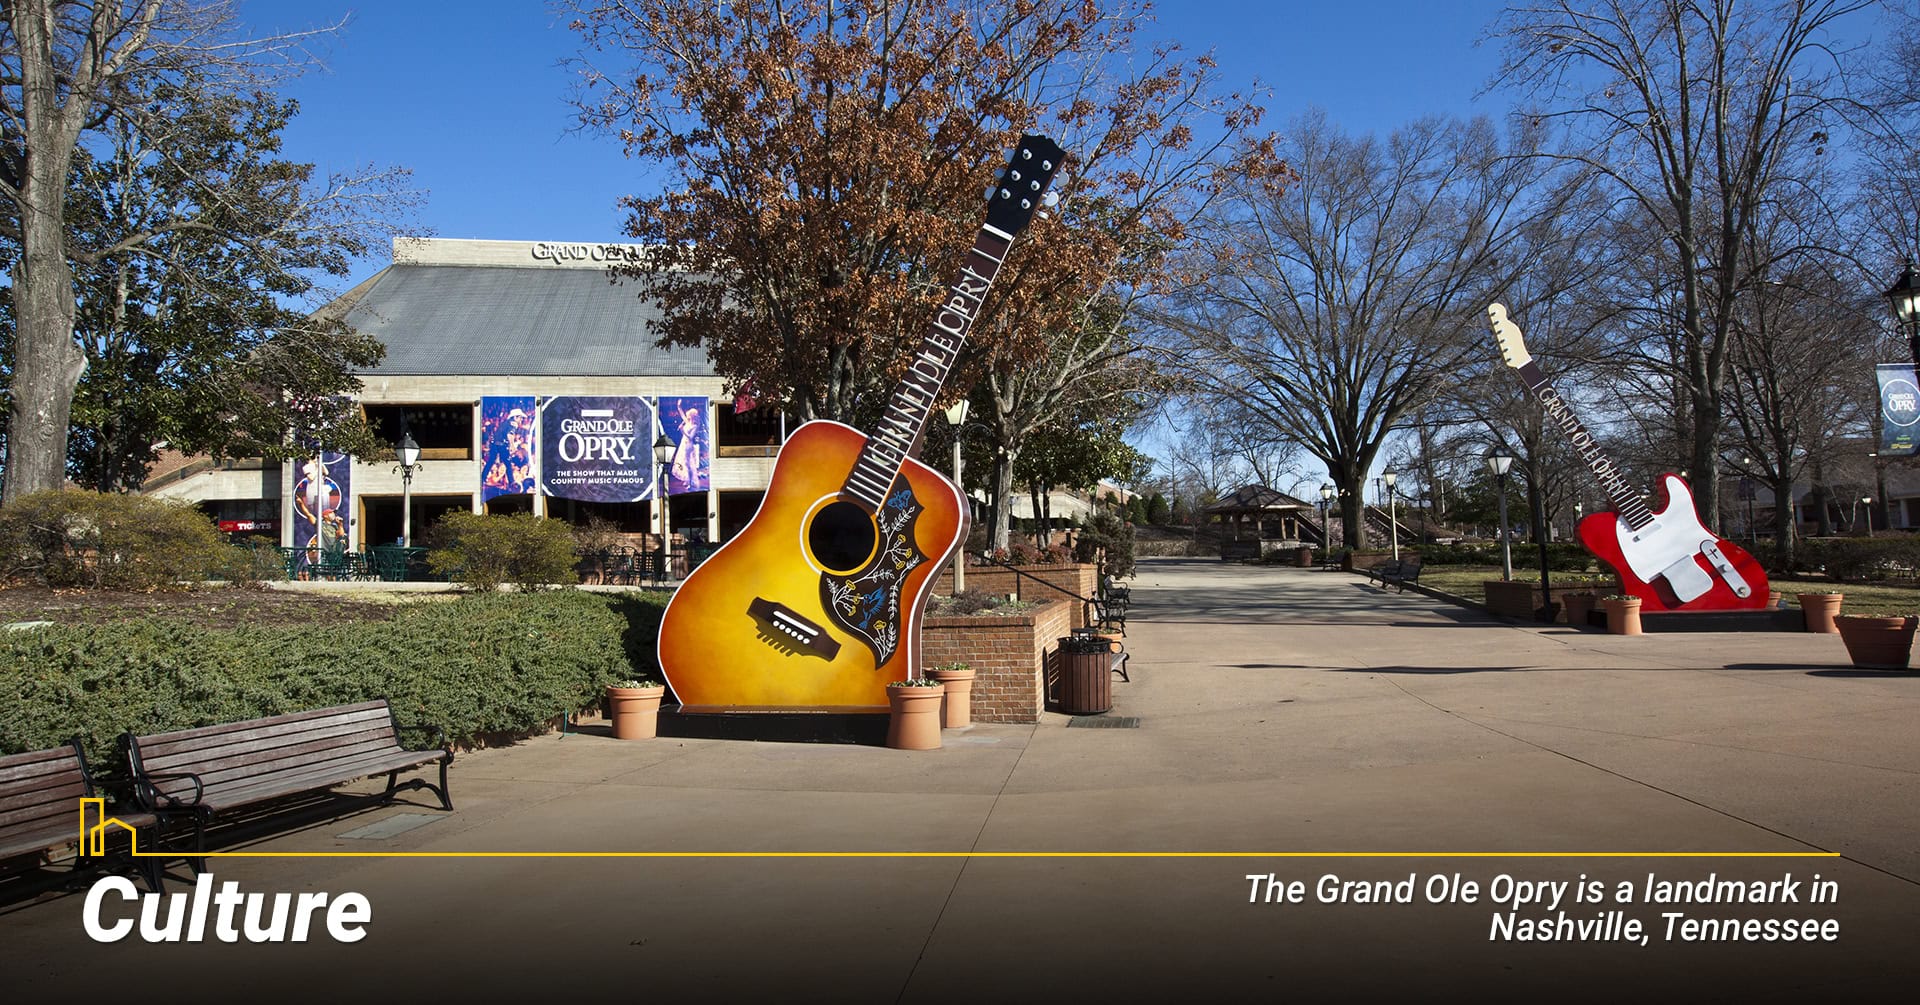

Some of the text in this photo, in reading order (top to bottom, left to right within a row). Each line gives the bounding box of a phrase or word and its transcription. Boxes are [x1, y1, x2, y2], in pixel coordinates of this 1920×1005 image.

[531, 243, 588, 264] GRAND
[871, 384, 926, 466] GRAND
[938, 265, 987, 335] OPRY
[561, 418, 634, 434] GRAND OLE
[1539, 387, 1577, 433] GRAND
[1571, 430, 1599, 462] OLE
